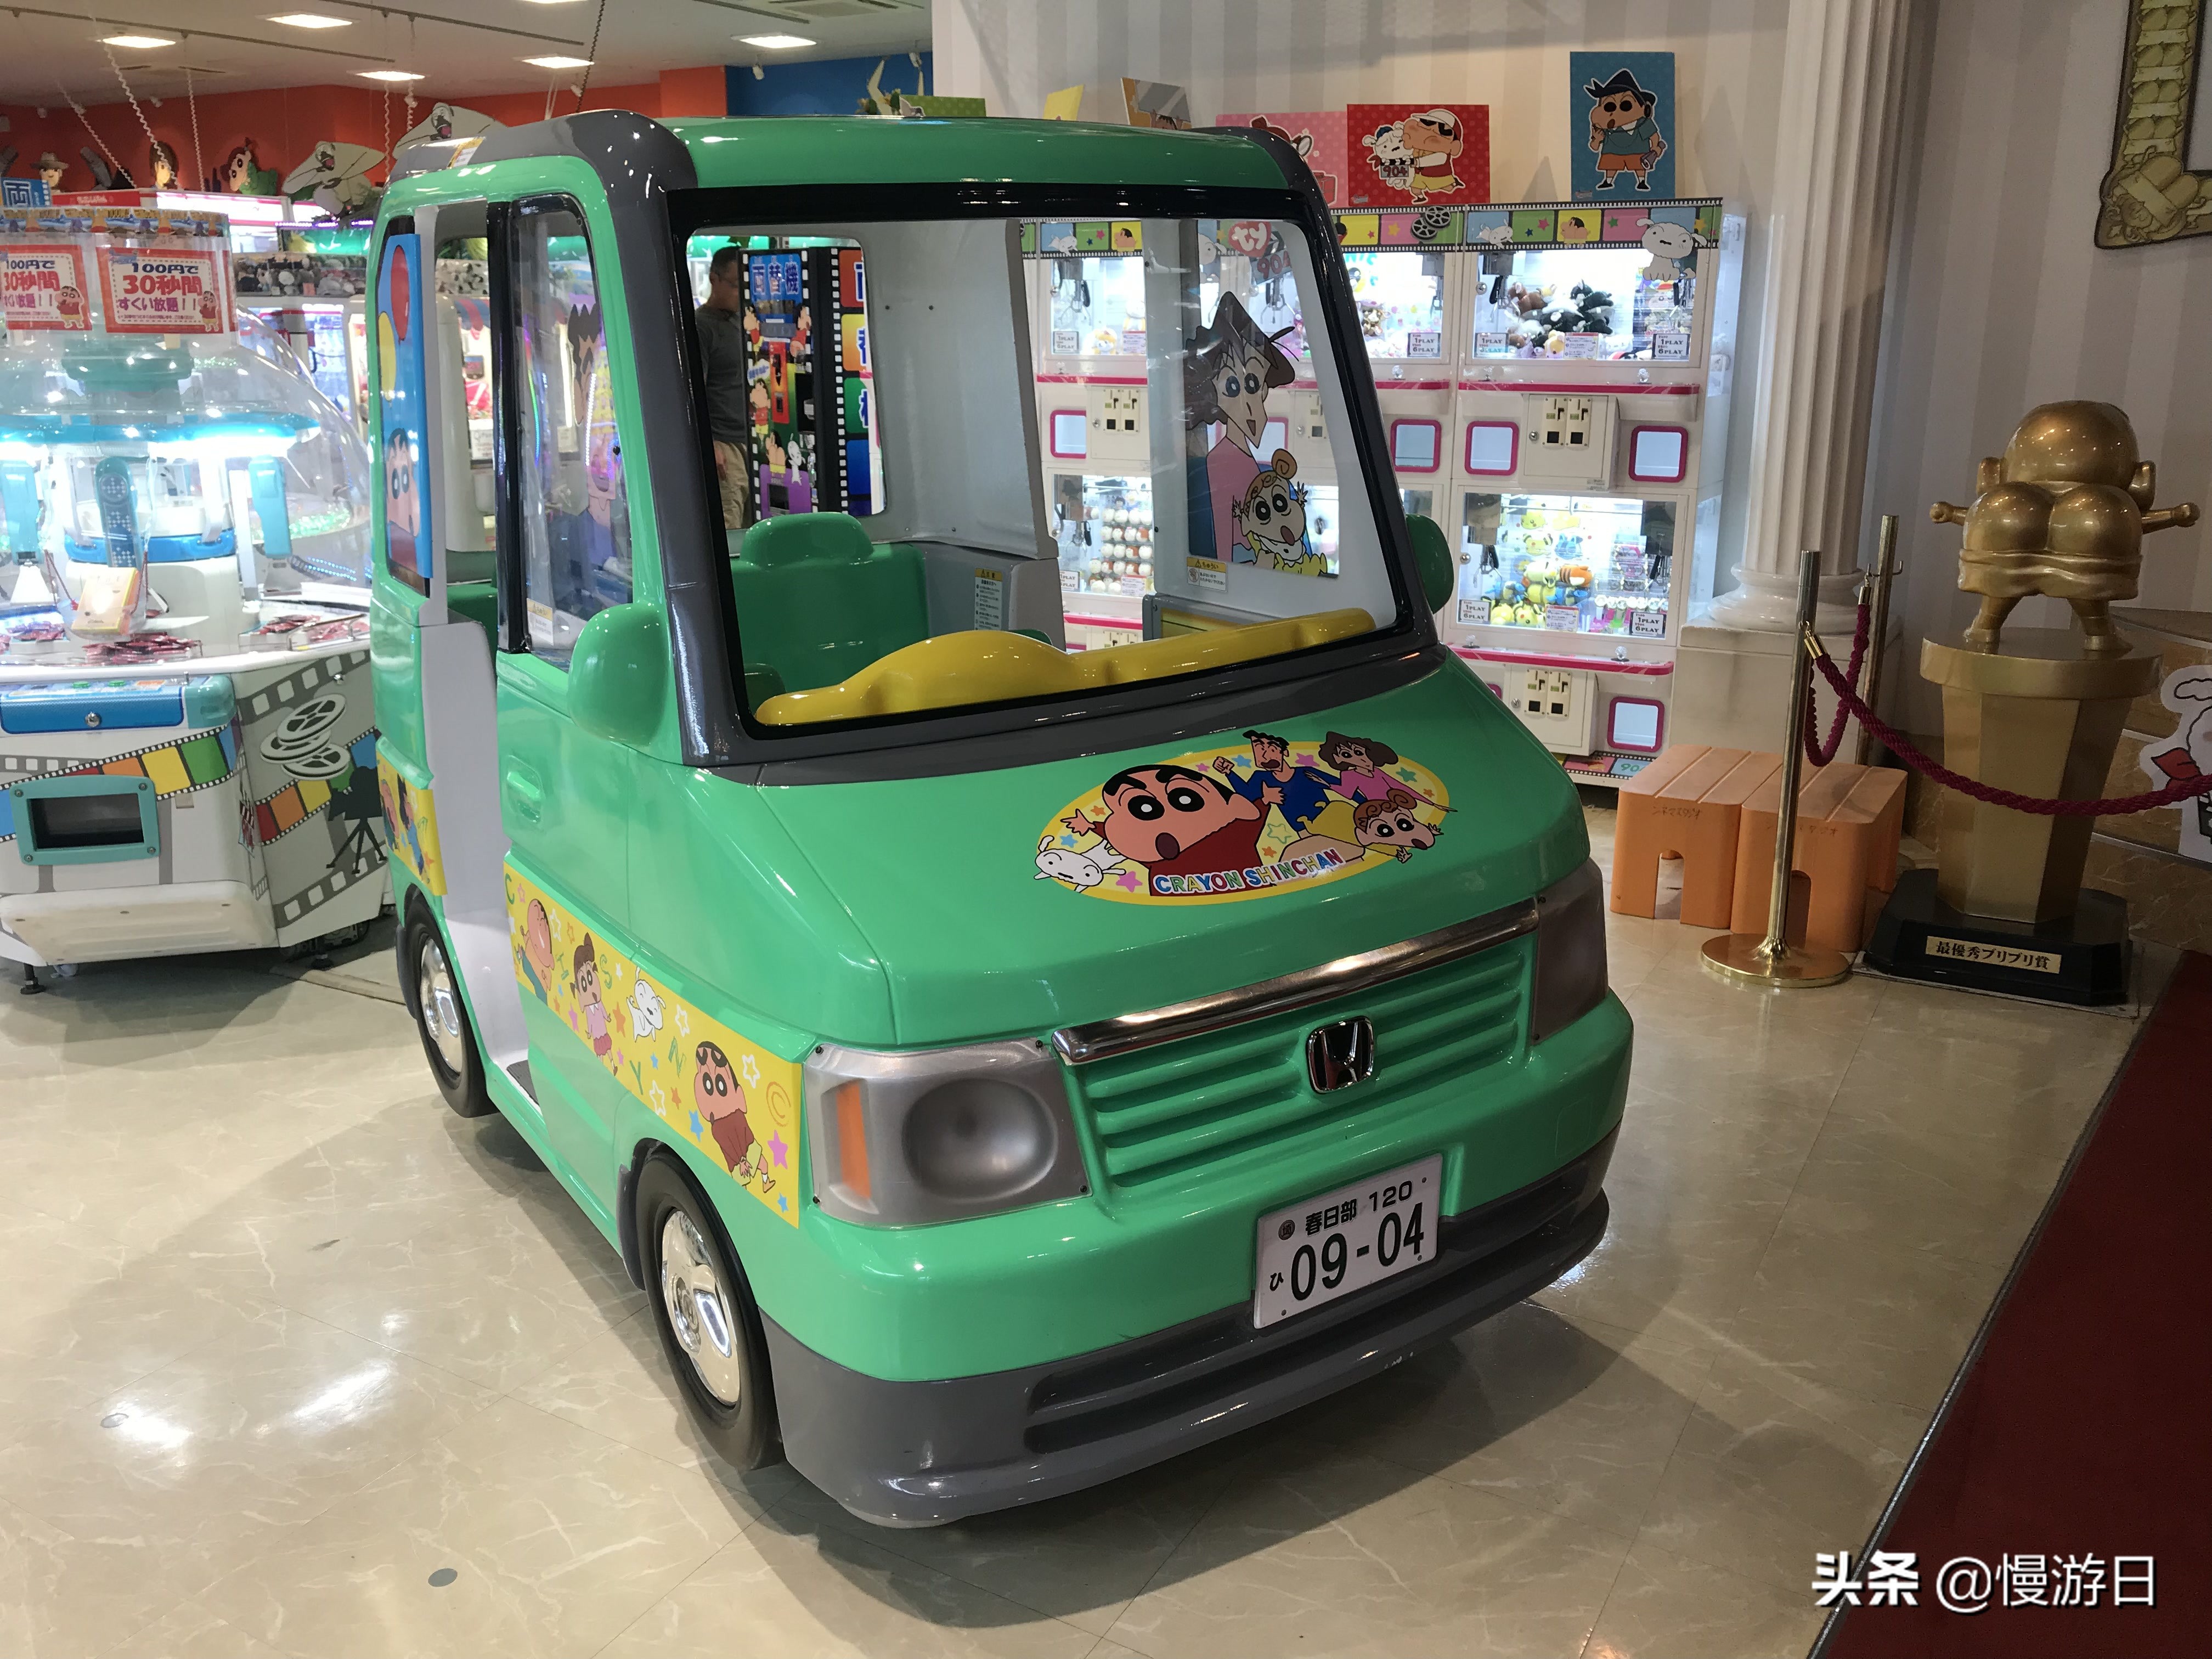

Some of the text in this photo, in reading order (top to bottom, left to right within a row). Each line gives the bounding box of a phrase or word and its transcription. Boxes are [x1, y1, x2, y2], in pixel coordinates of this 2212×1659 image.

[1383, 165, 1408, 177] 904
[1231, 222, 1267, 251] ty
[132, 262, 199, 274] 100円で
[122, 274, 203, 296] 30秒間
[1621, 763, 1646, 772] 90
[1155, 849, 1344, 893] CRAYON SHINCHAN
[1305, 1198, 1357, 1236] 春日部
[1369, 1181, 1412, 1212] 120
[1269, 1202, 1424, 1301] ひ 09-04
